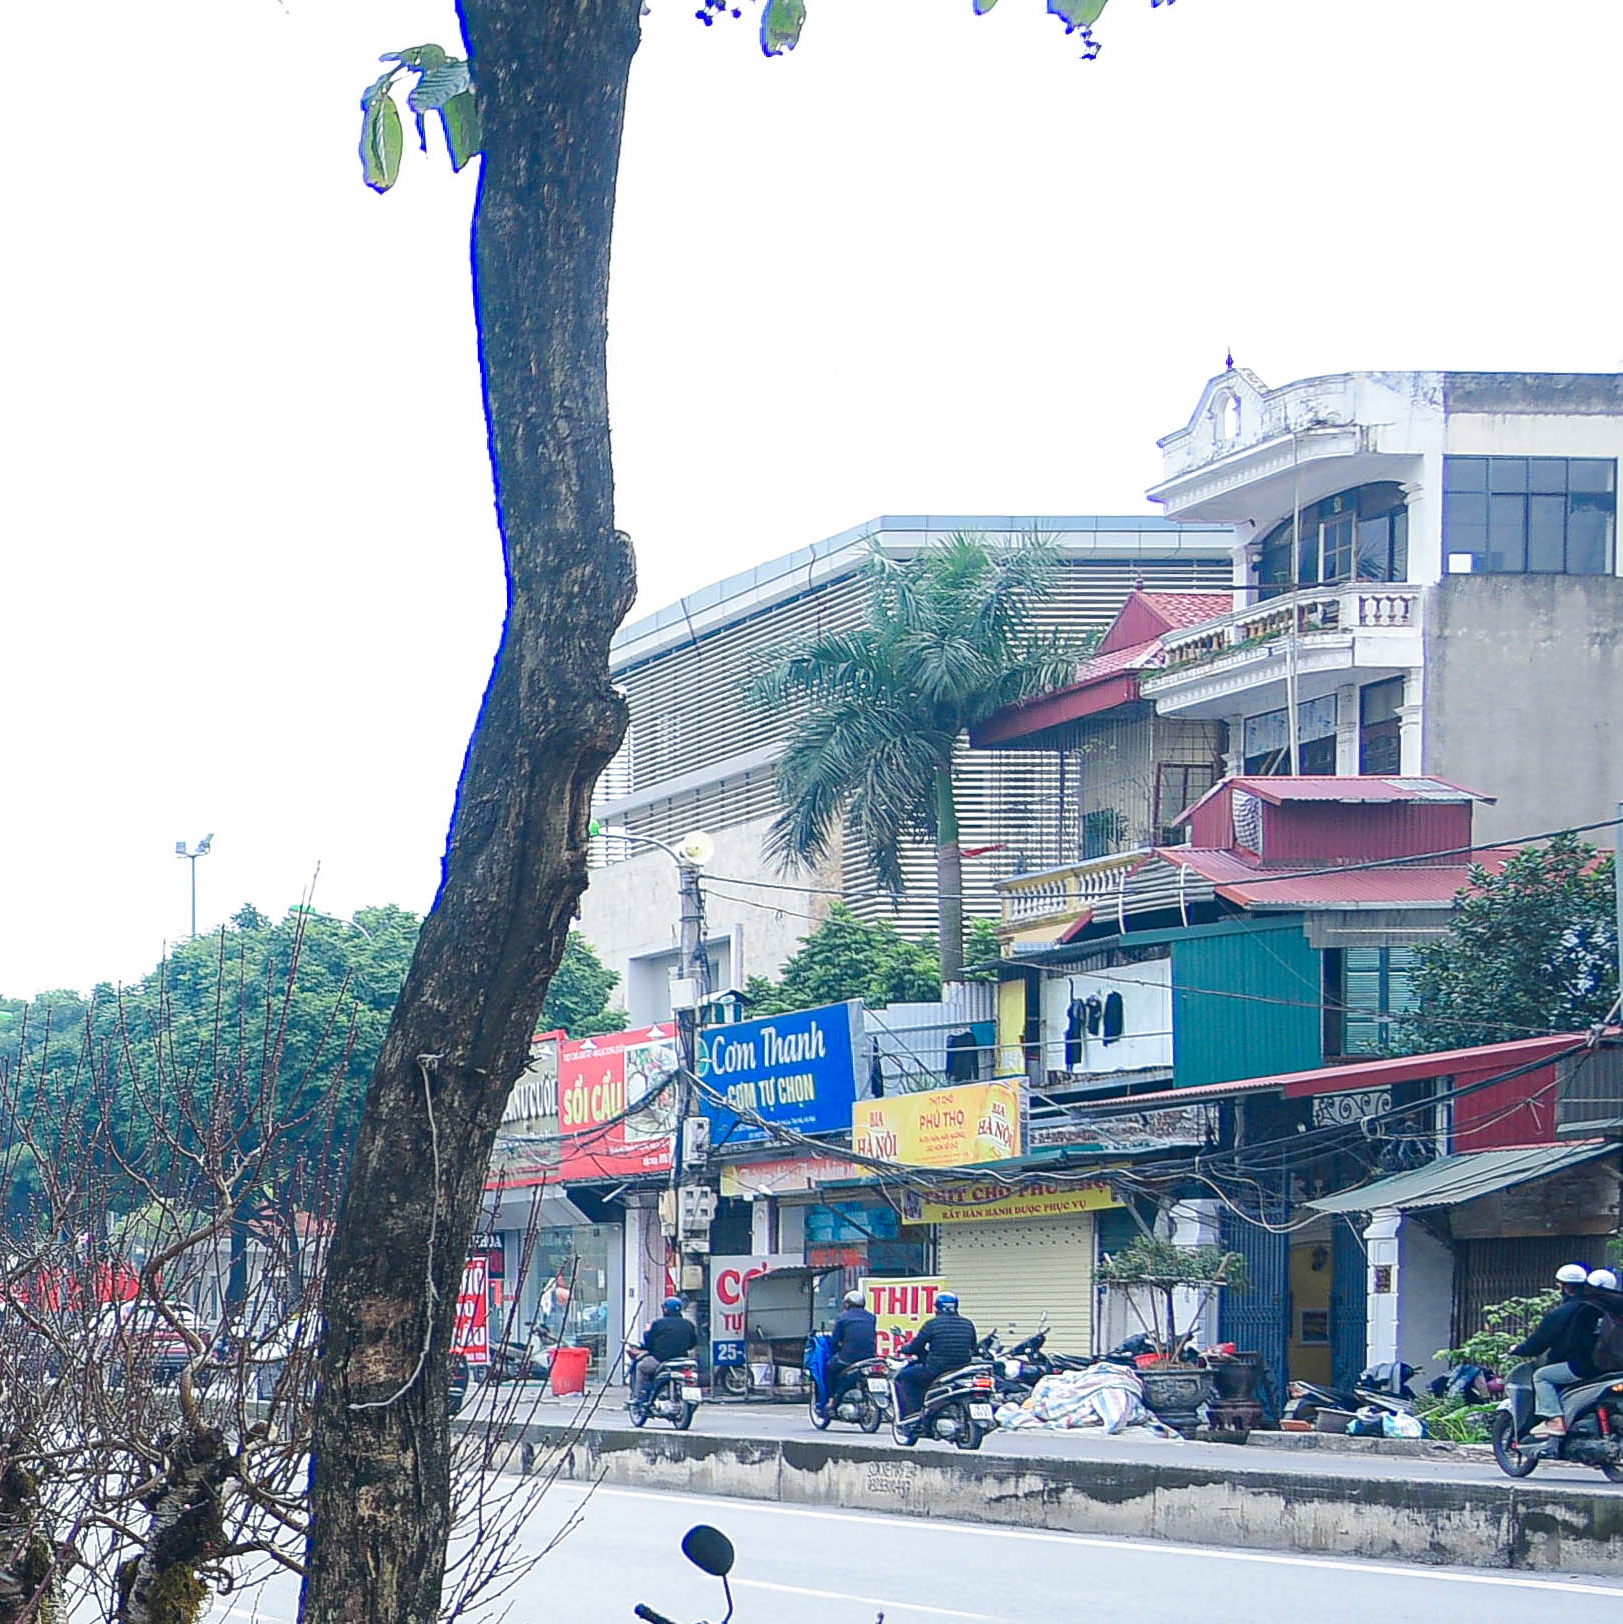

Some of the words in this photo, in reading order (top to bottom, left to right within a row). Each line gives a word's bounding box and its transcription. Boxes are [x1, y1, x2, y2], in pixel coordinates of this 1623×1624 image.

[712, 1035, 757, 1075] Cơm
[761, 1020, 826, 1068] Thanh
[758, 1076, 776, 1112] TỰ
[777, 1074, 816, 1108] CHỌN
[869, 1285, 938, 1321] THỊT
[718, 1344, 745, 1362] 25-
